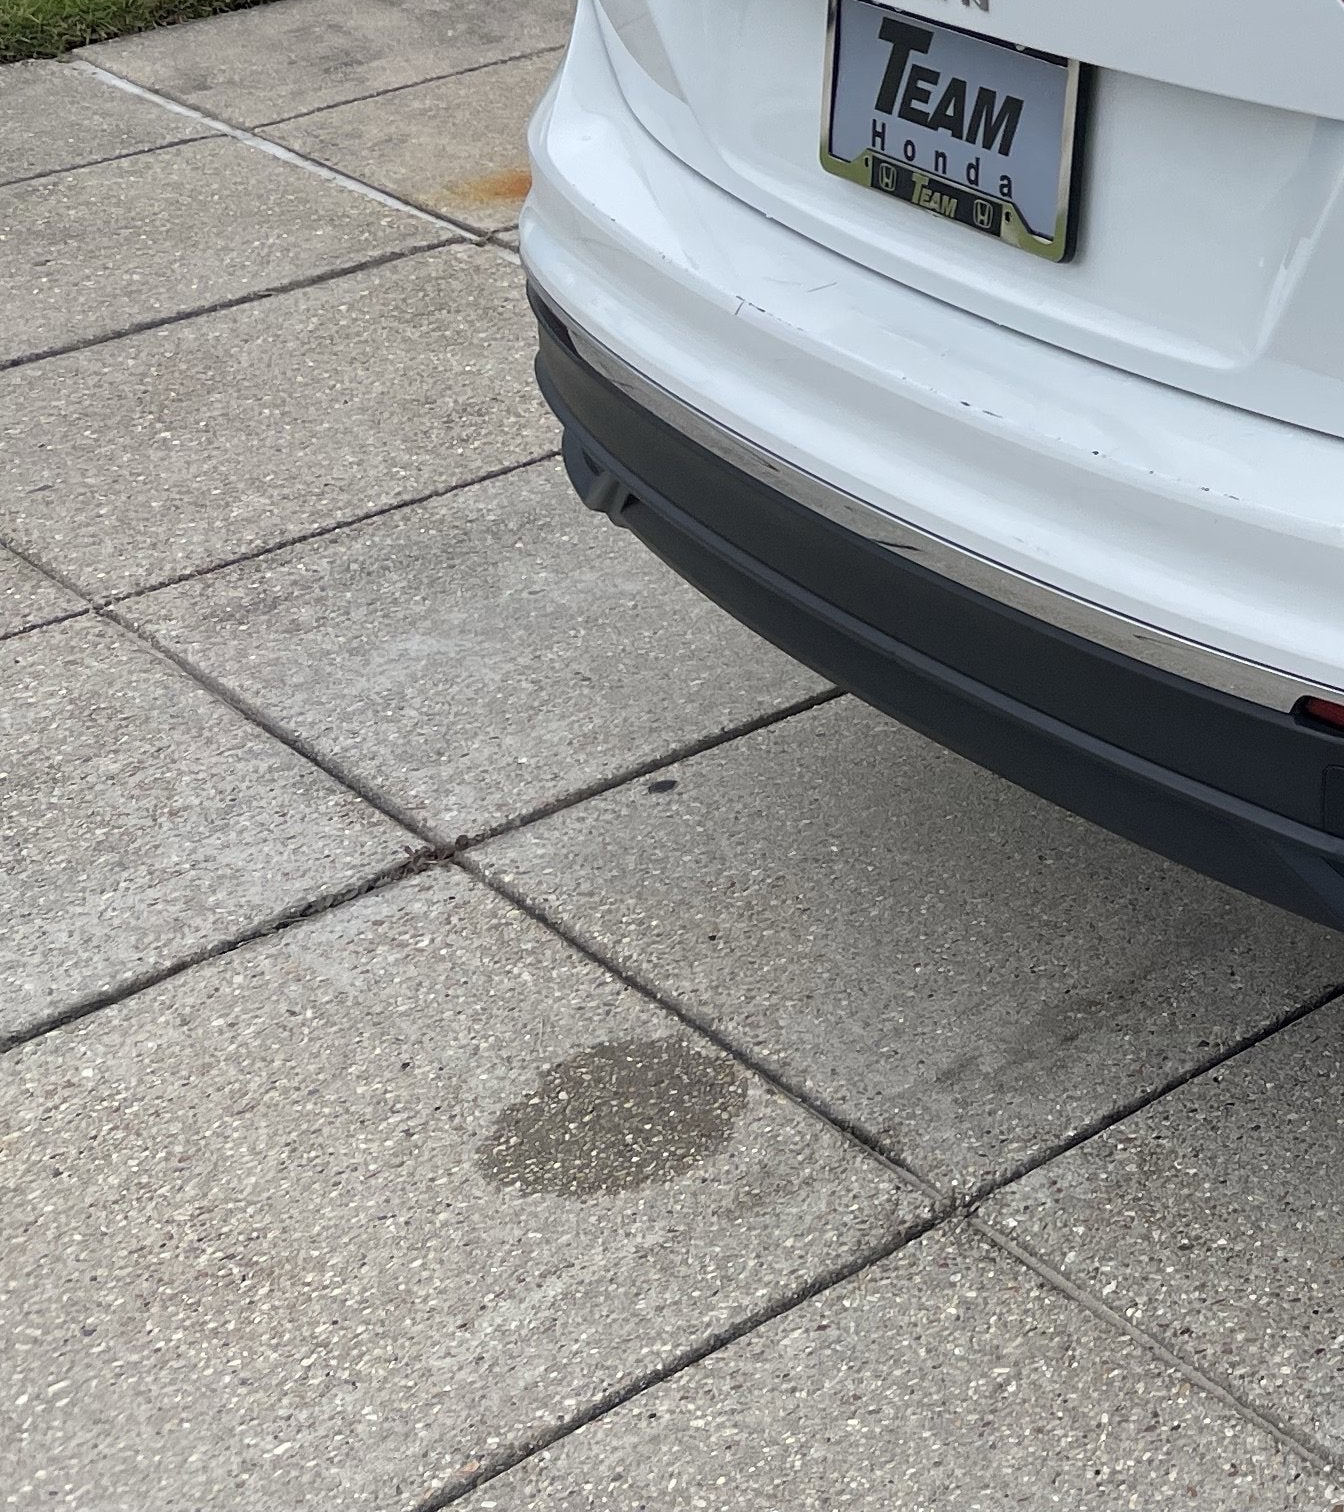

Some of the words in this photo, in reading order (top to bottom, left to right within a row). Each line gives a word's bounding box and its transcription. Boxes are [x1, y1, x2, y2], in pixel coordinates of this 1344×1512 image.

[874, 16, 1024, 157] TEAM
[871, 118, 1013, 198] Honda
[911, 172, 958, 218] TEAM
